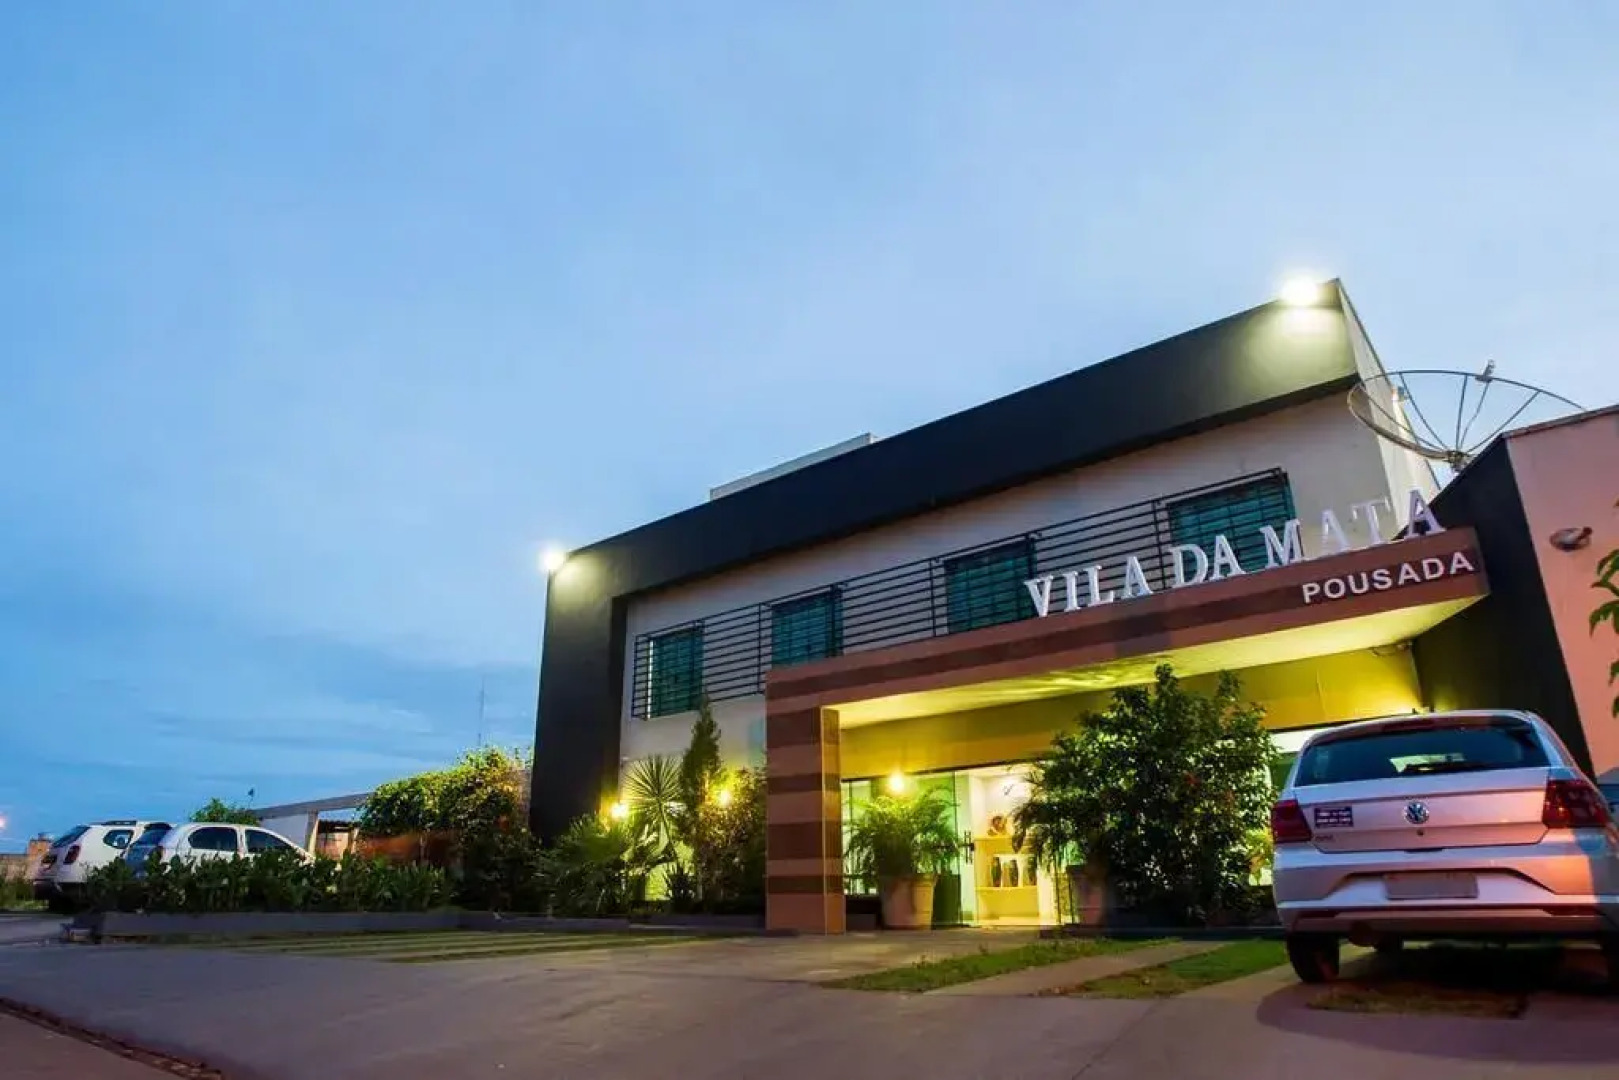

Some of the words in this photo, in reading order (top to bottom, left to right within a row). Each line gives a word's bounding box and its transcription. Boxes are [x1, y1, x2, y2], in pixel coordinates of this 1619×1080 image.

[1024, 555, 1153, 618] VILA
[1169, 533, 1247, 589] DA
[1259, 486, 1446, 570] MATA
[1301, 551, 1474, 604] POUSADA
